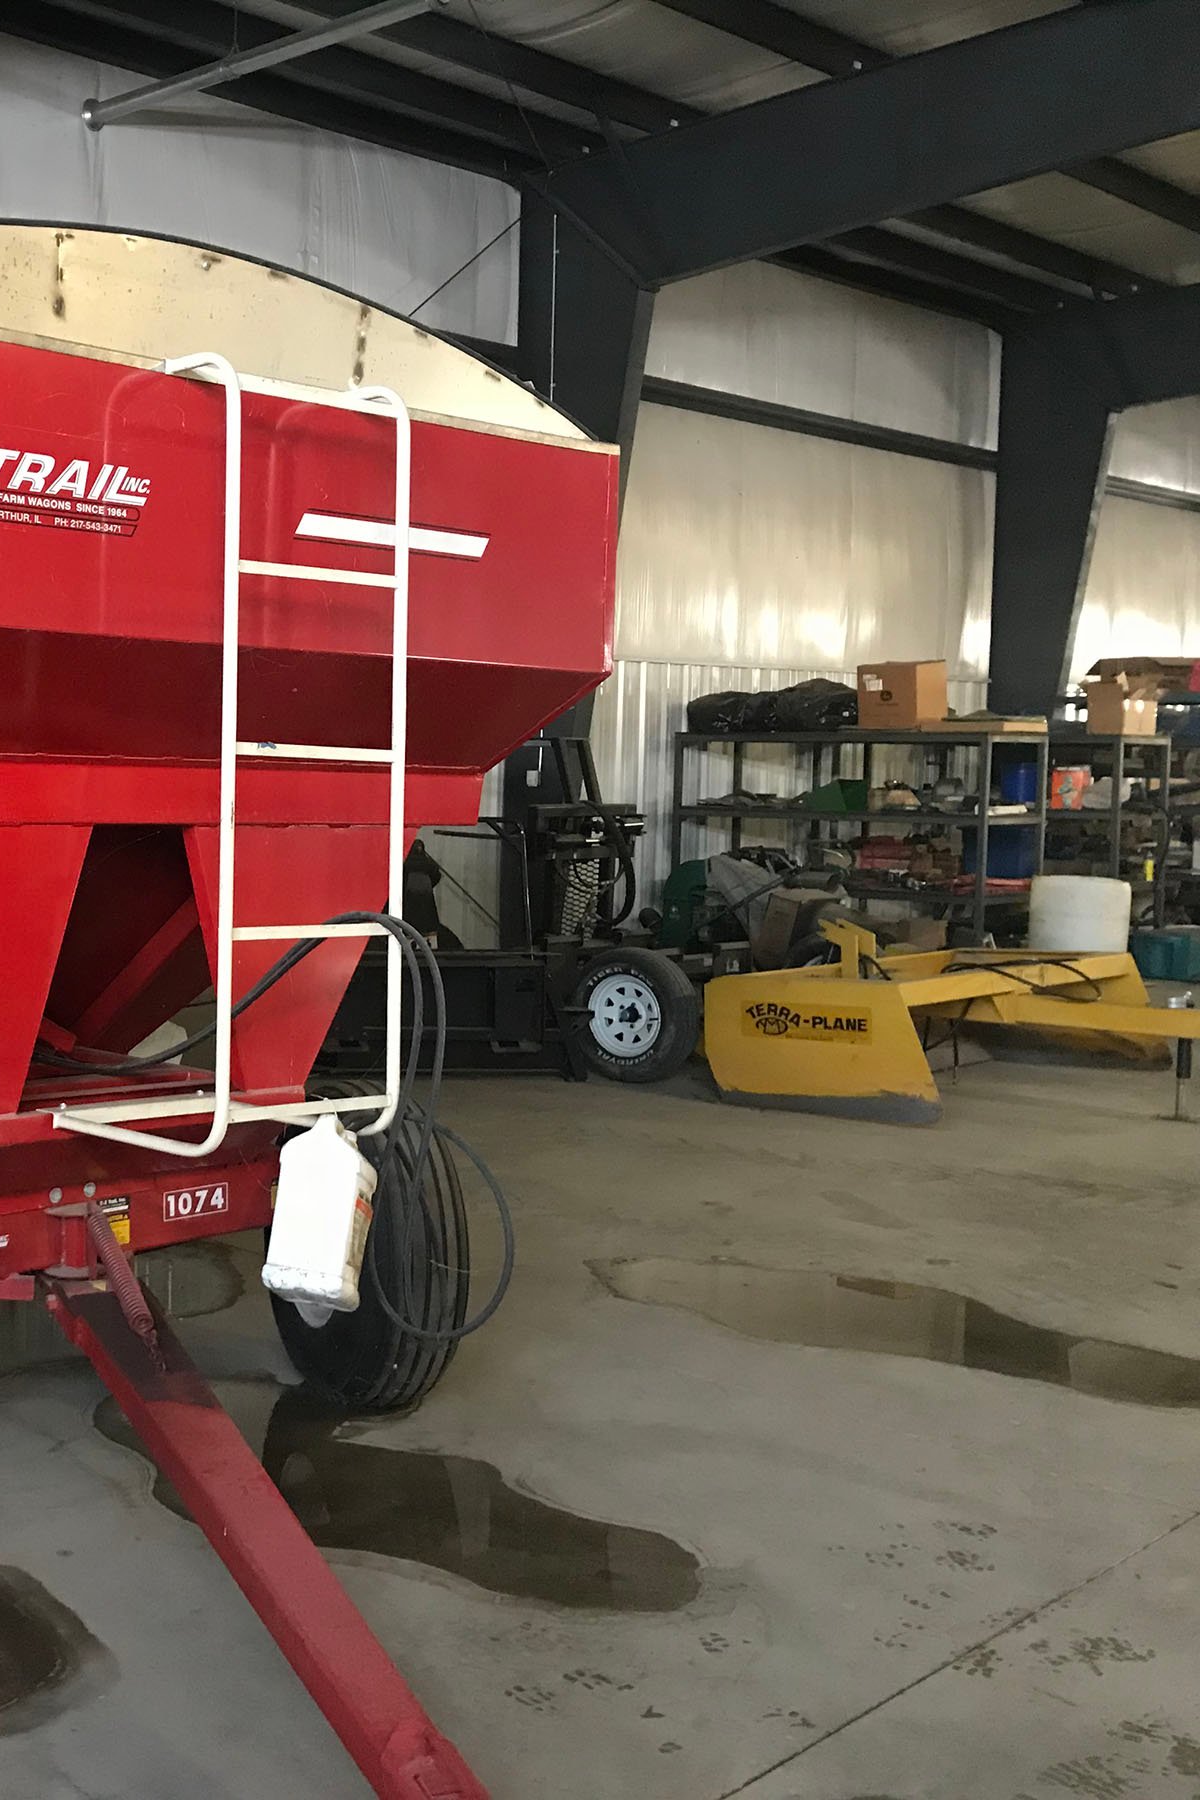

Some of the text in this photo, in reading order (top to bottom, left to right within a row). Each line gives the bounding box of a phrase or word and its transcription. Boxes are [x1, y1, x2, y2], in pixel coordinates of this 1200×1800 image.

[28, 497, 72, 511] WAGONS
[76, 503, 104, 515] SINCE
[107, 507, 127, 518] 1964
[34, 514, 42, 524] IL
[70, 519, 122, 534] 217-543-3471
[167, 1186, 225, 1217] 1074
